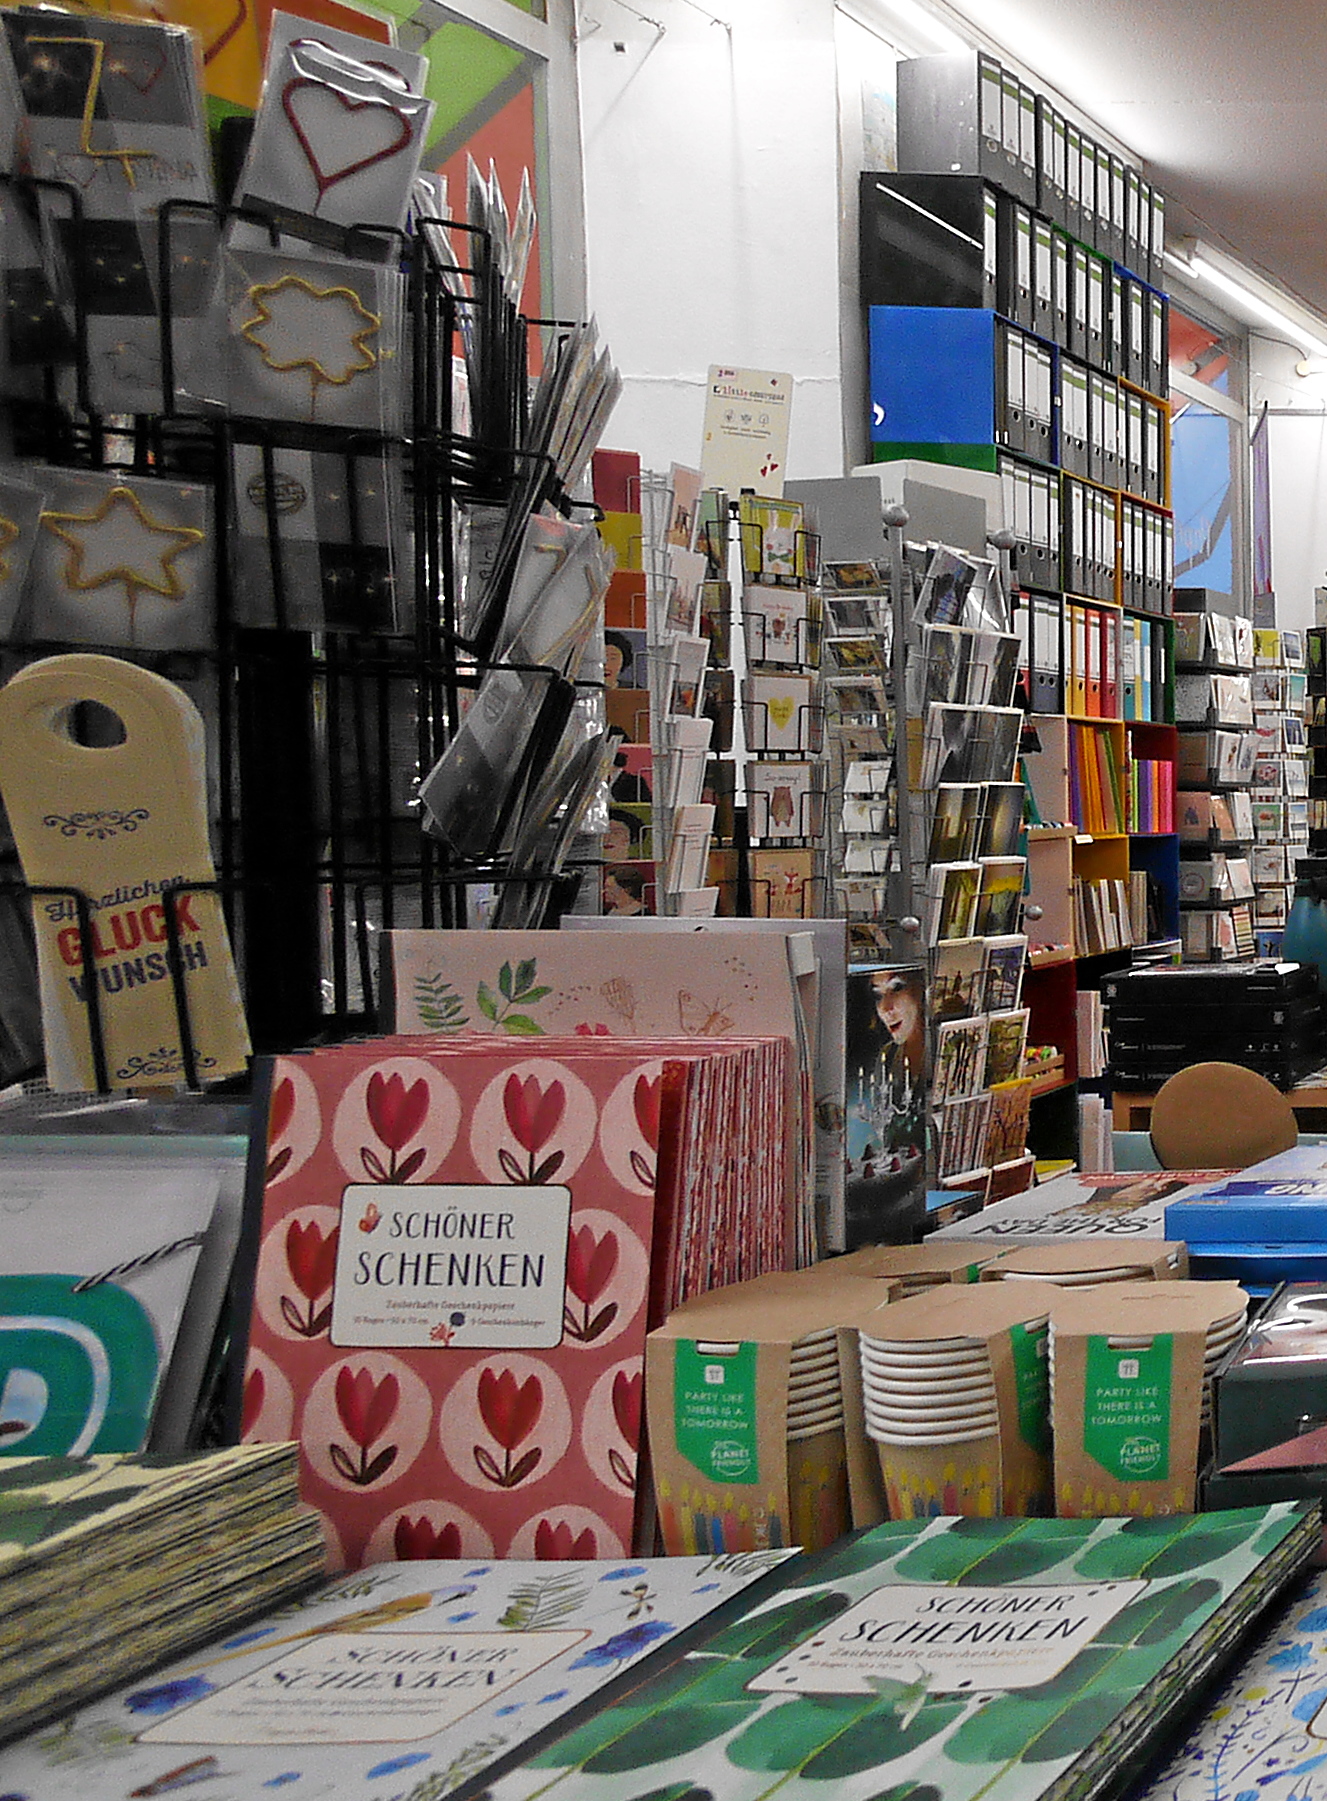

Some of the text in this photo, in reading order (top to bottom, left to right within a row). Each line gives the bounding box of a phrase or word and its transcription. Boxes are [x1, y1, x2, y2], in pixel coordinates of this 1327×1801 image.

[45, 875, 190, 922] Hrzlichen
[68, 940, 209, 1003] UNSH
[389, 1205, 515, 1239] SCHÖNER
[974, 1220, 1149, 1235] QUEEN
[354, 1251, 545, 1288] SCHENKEN
[684, 1392, 719, 1401] PARTY
[1096, 1387, 1159, 1397] PARTY LIKE
[1098, 1401, 1157, 1412] THERE IS A
[682, 1418, 749, 1430] TOMORROW
[1091, 1413, 1162, 1425] TOMORROW
[1120, 1442, 1160, 1456] PLANET
[917, 1591, 1075, 1614] SCHÖNER
[839, 1615, 1090, 1645] SCHENKEN
[248, 1666, 518, 1689] SCHENKEN
